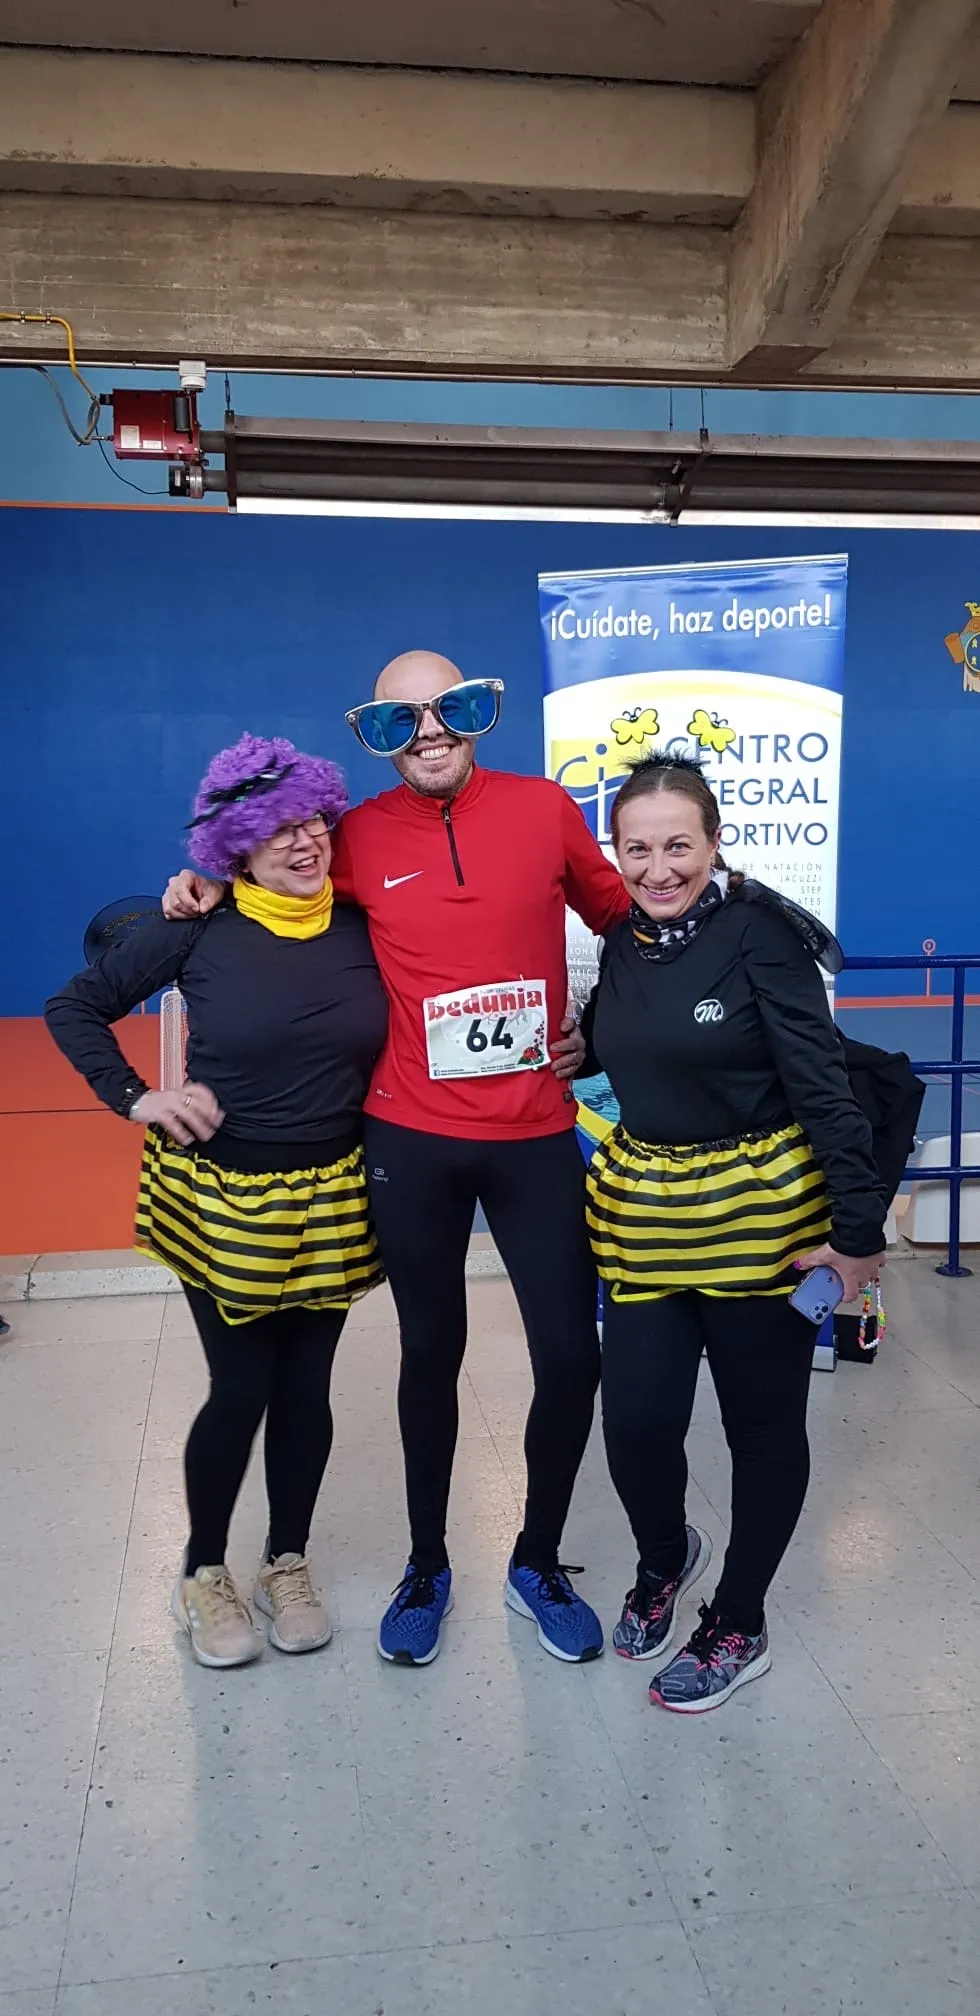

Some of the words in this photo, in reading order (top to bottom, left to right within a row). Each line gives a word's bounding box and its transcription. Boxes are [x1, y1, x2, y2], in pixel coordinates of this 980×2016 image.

[551, 605, 660, 641] ¡Cuídate,
[669, 601, 714, 634] haz
[722, 593, 832, 638] deporte!
[707, 777, 828, 806] EGRAL
[719, 822, 828, 846] ORTIVO
[764, 862, 822, 871] NATACIÓN
[780, 874, 822, 883] JACUZZI
[800, 886, 822, 894] STEP
[427, 988, 543, 1020] bedunia
[466, 1016, 514, 1053] 64
